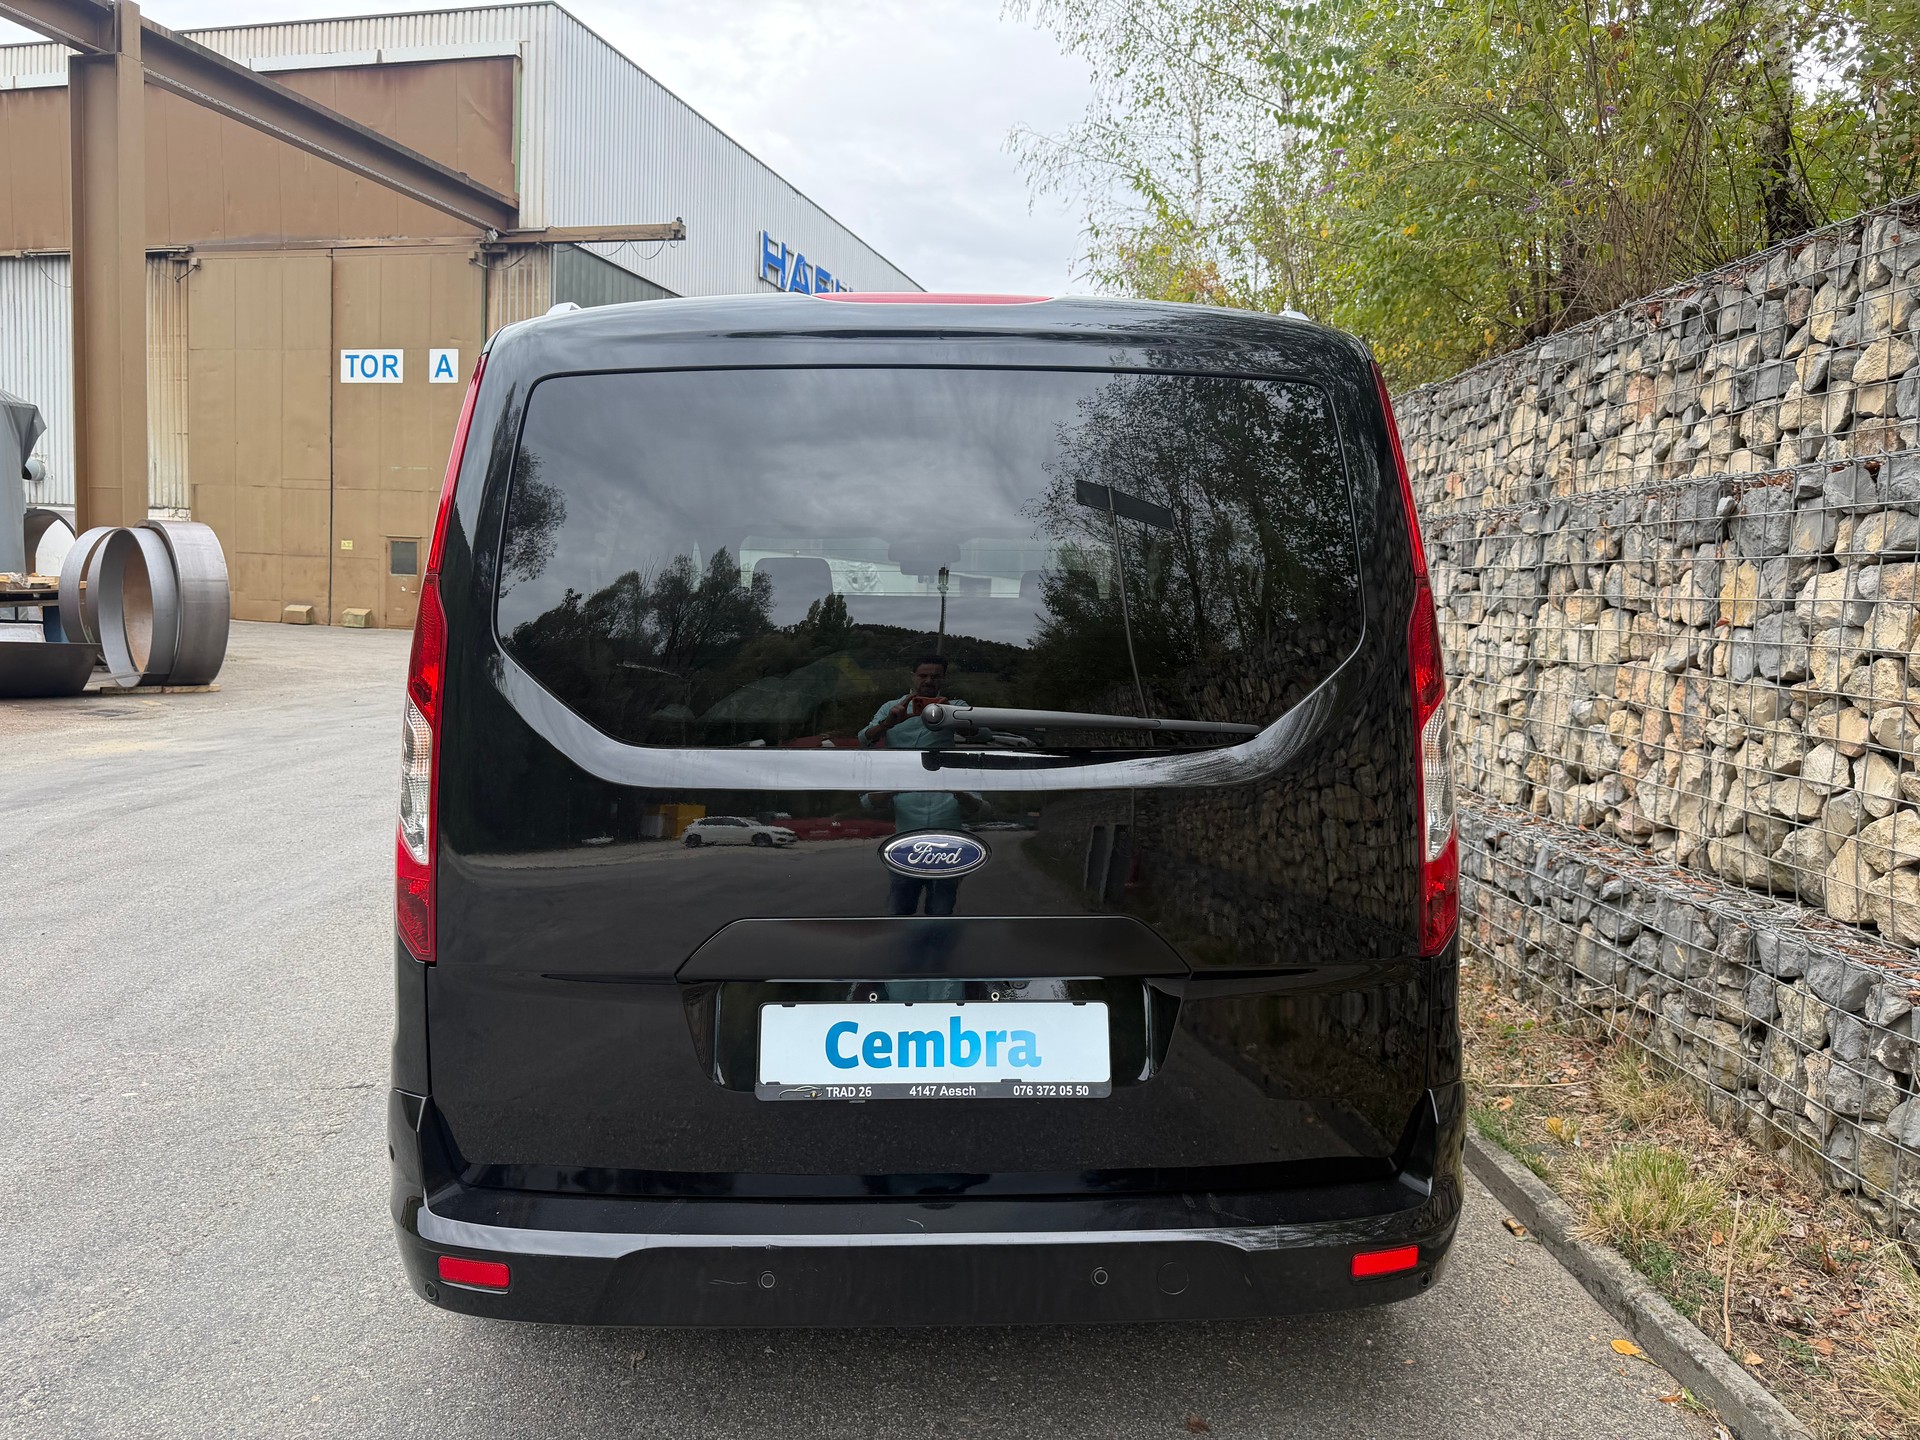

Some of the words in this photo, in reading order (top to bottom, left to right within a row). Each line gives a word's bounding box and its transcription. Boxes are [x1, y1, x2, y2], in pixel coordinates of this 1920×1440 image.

[344, 354, 400, 379] TOR
[434, 353, 454, 378] A
[907, 841, 963, 865] Ford
[824, 1015, 1043, 1070] Cembra
[825, 1086, 857, 1098] TRAD
[858, 1086, 873, 1097] 26
[909, 1085, 938, 1097] 4147
[939, 1085, 977, 1097] Aesch
[1013, 1085, 1034, 1096] 076
[1036, 1085, 1057, 1096] 372
[1059, 1085, 1073, 1096] 05
[1075, 1085, 1090, 1096] 50
